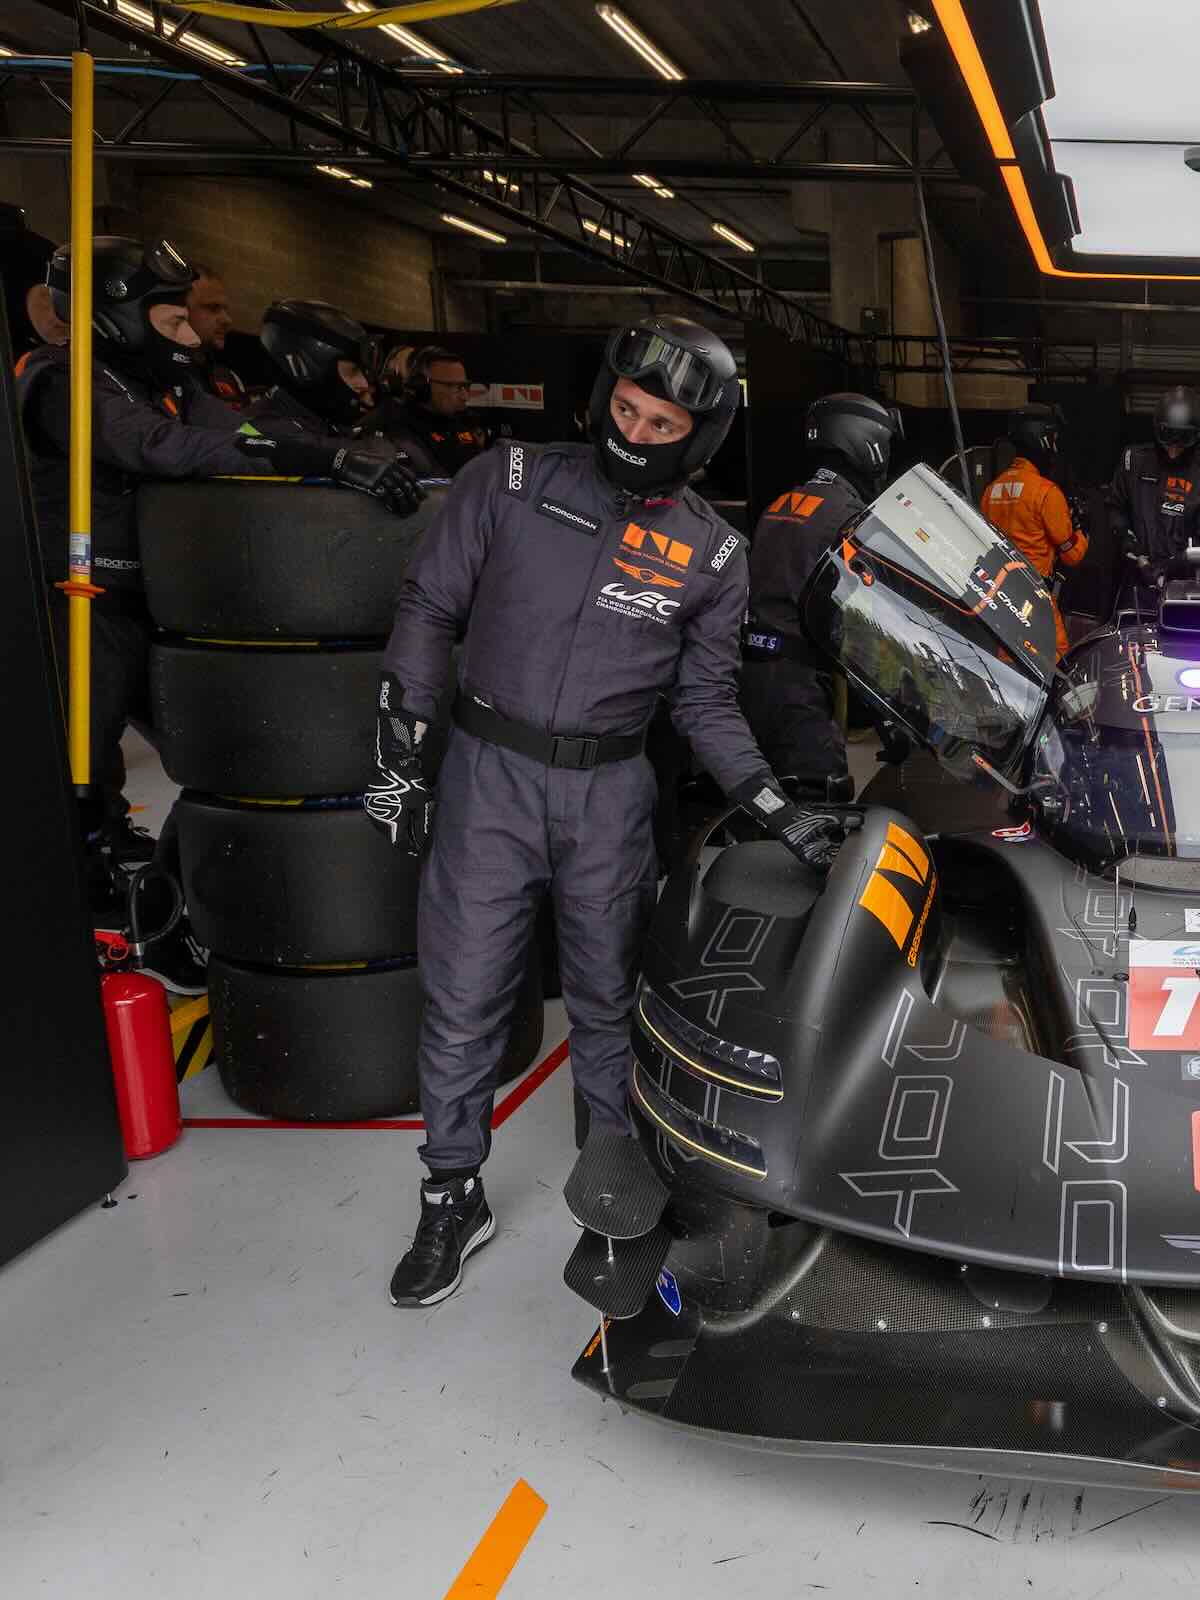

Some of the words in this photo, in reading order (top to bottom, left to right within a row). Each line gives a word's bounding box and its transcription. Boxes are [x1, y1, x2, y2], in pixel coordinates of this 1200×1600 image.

[509, 446, 525, 491] sparco
[607, 437, 648, 466] sparco
[711, 534, 739, 572] sparco
[599, 583, 681, 616] WEC
